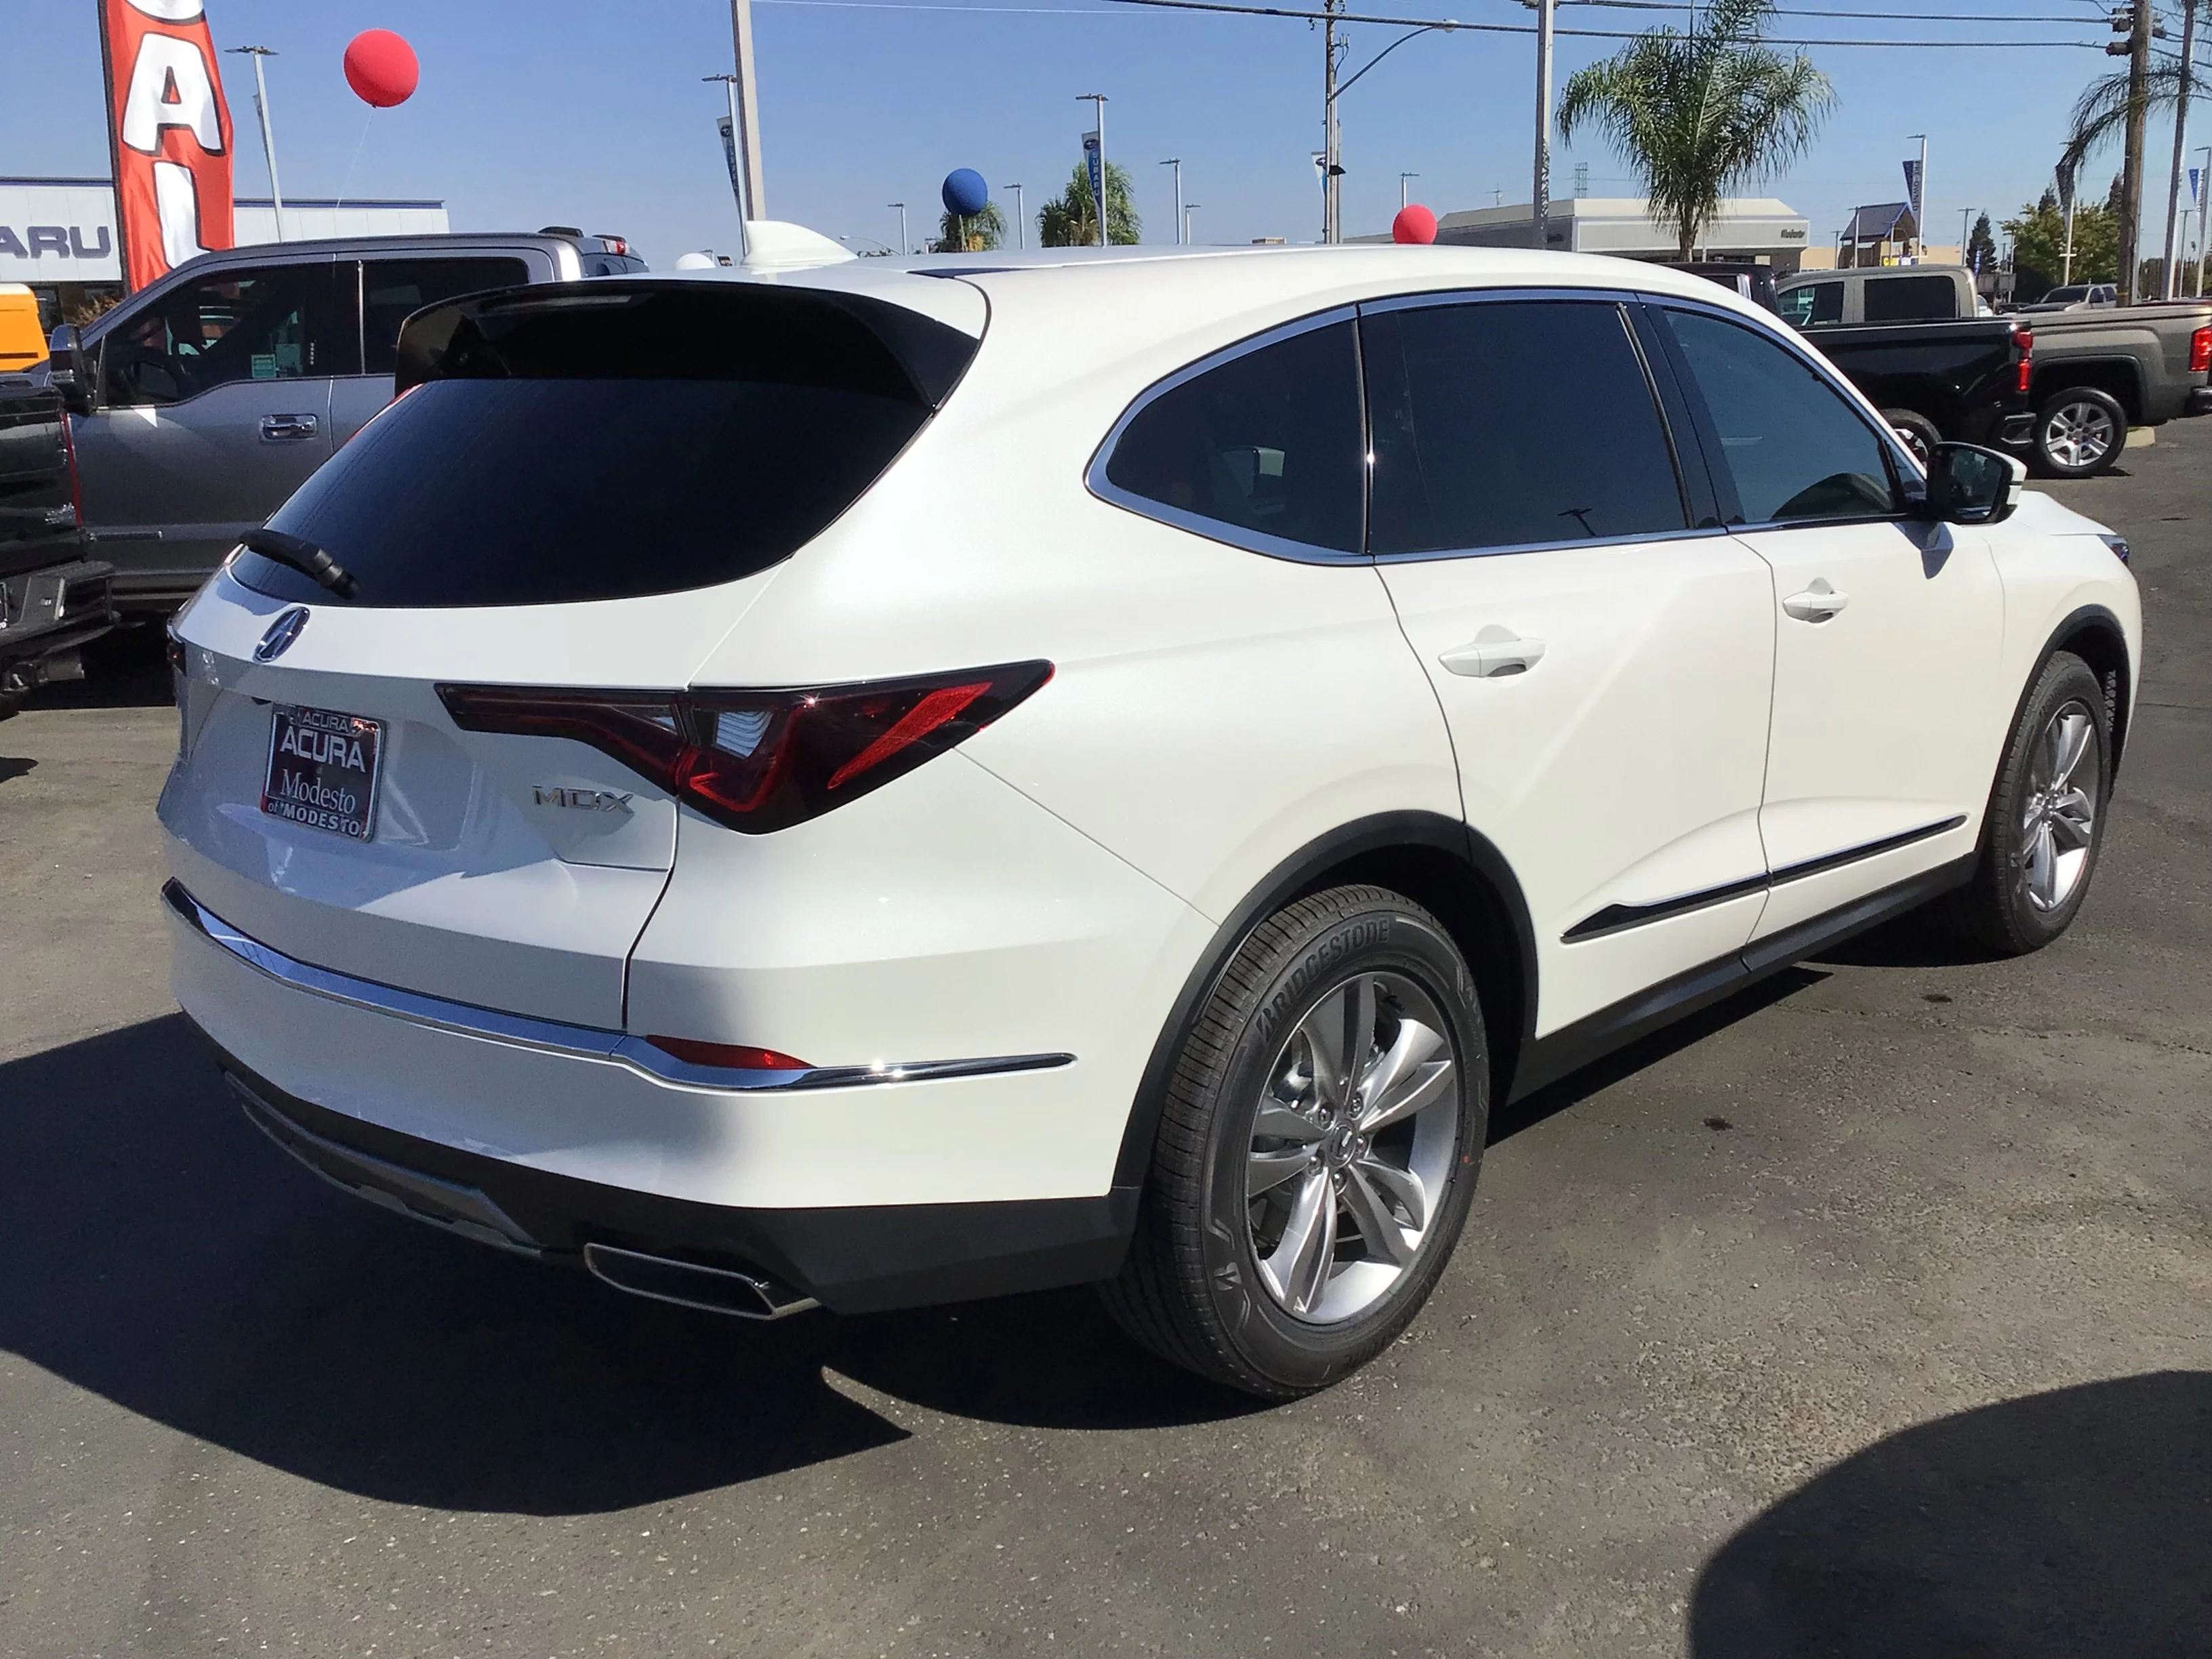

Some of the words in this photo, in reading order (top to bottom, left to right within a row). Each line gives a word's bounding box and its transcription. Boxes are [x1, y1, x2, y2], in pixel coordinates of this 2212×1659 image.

[302, 711, 349, 733] ACURA
[280, 725, 367, 773] ACURA
[280, 769, 356, 815] Modesto
[532, 784, 636, 815] MDX
[268, 800, 280, 814] of
[281, 804, 361, 836] MODESTO
[1255, 919, 1389, 1042] BRIDGESTONE
